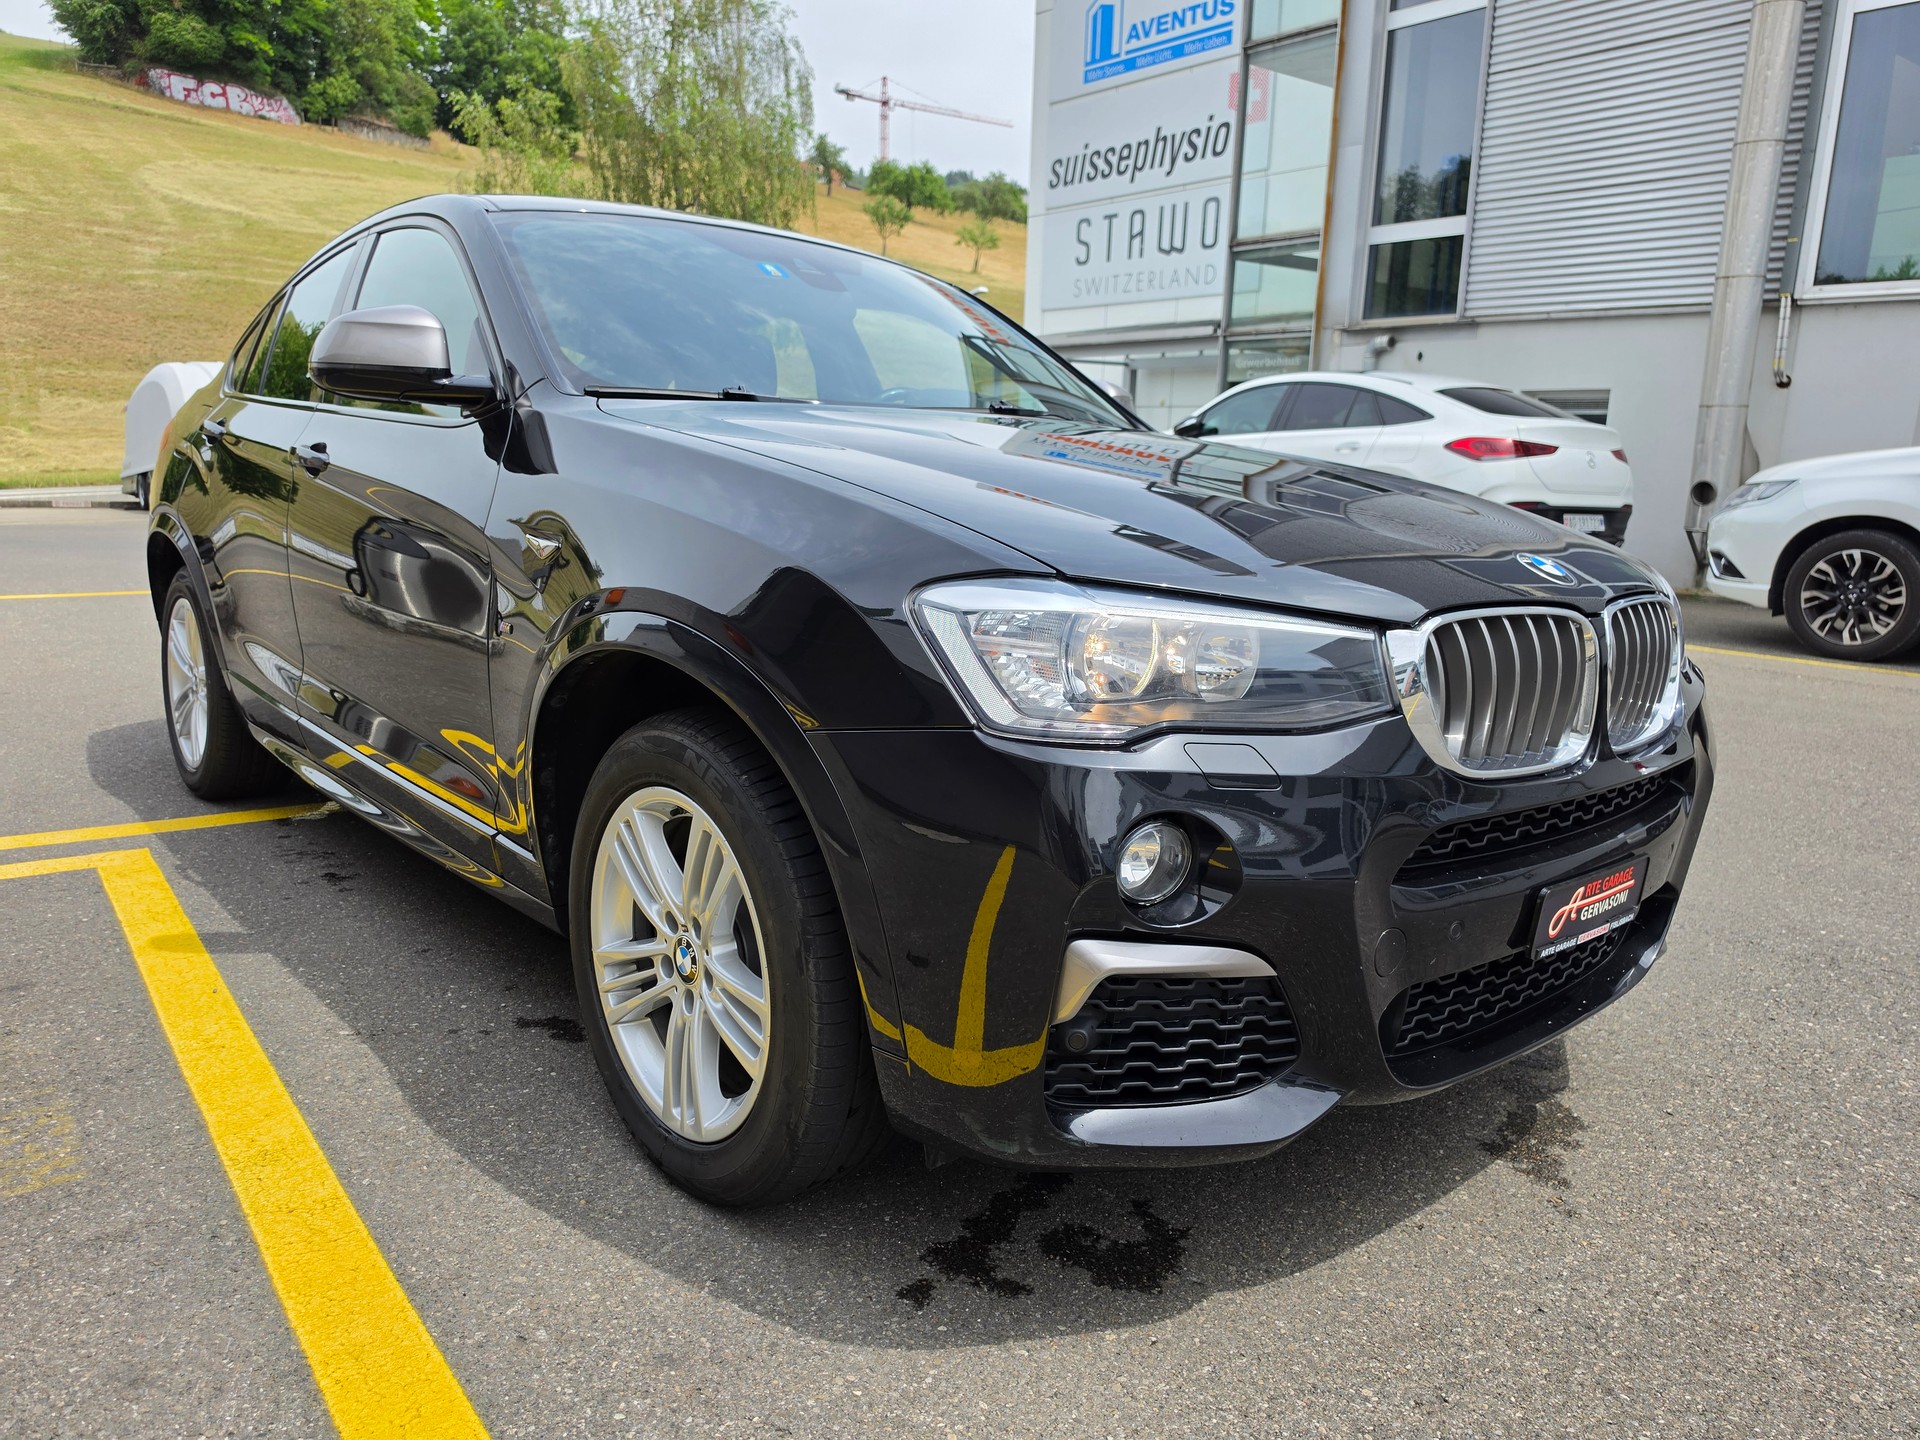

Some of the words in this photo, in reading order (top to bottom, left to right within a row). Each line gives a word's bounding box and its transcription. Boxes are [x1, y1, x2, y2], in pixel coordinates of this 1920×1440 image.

[1126, 0, 1235, 44] AVENTUS
[1049, 114, 1231, 189] suissephysio
[1075, 196, 1221, 266] STAWO
[1073, 263, 1217, 298] SWITZERLAND
[1602, 866, 1634, 892] GARAGE
[1580, 889, 1629, 921] GERVASONI
[1540, 945, 1556, 958] ARTE
[1555, 938, 1577, 953] GARAGE
